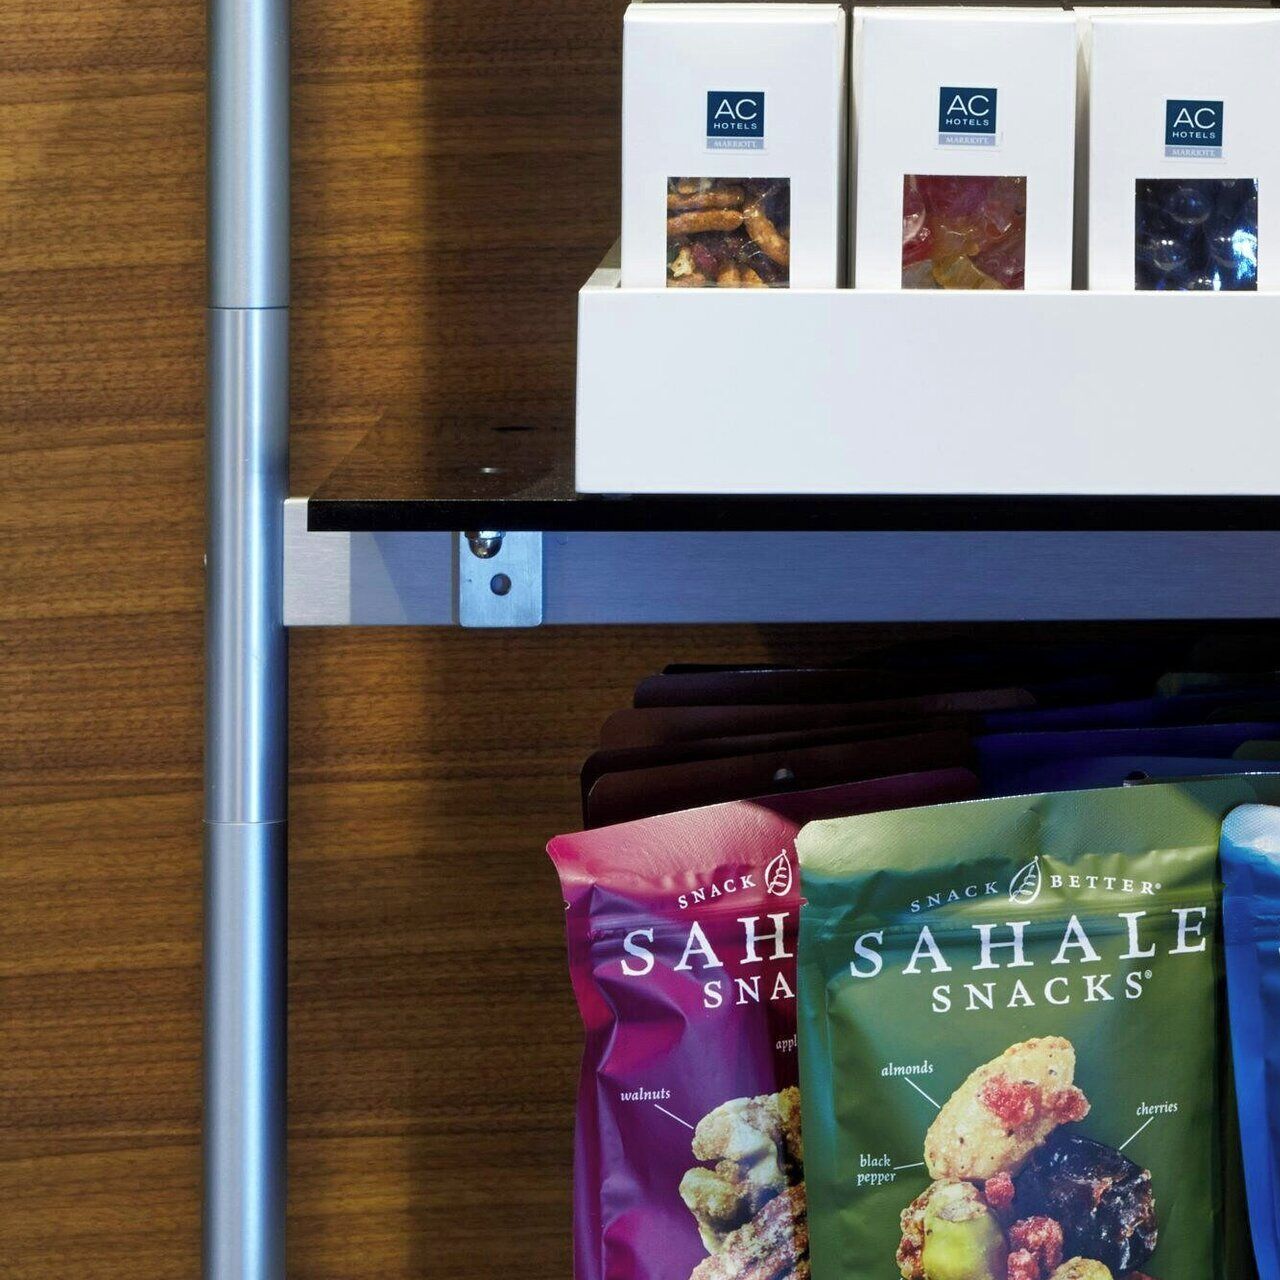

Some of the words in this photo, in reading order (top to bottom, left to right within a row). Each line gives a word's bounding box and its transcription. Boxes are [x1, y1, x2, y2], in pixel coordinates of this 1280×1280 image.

[714, 99, 757, 120] AC
[946, 95, 989, 117] AC
[713, 122, 758, 130] HOTELS
[945, 118, 990, 127] HOTELS
[1173, 107, 1216, 130] AC
[1172, 131, 1216, 139] HOTELS
[678, 874, 756, 910] SNACK
[910, 881, 1000, 913] SNACK
[850, 906, 1208, 979] SAHALE
[881, 1060, 934, 1077] almonds
[620, 1087, 670, 1102] walnuts
[1136, 1100, 1178, 1117] cherries
[859, 1153, 892, 1168] black
[856, 1168, 897, 1187] pepper
